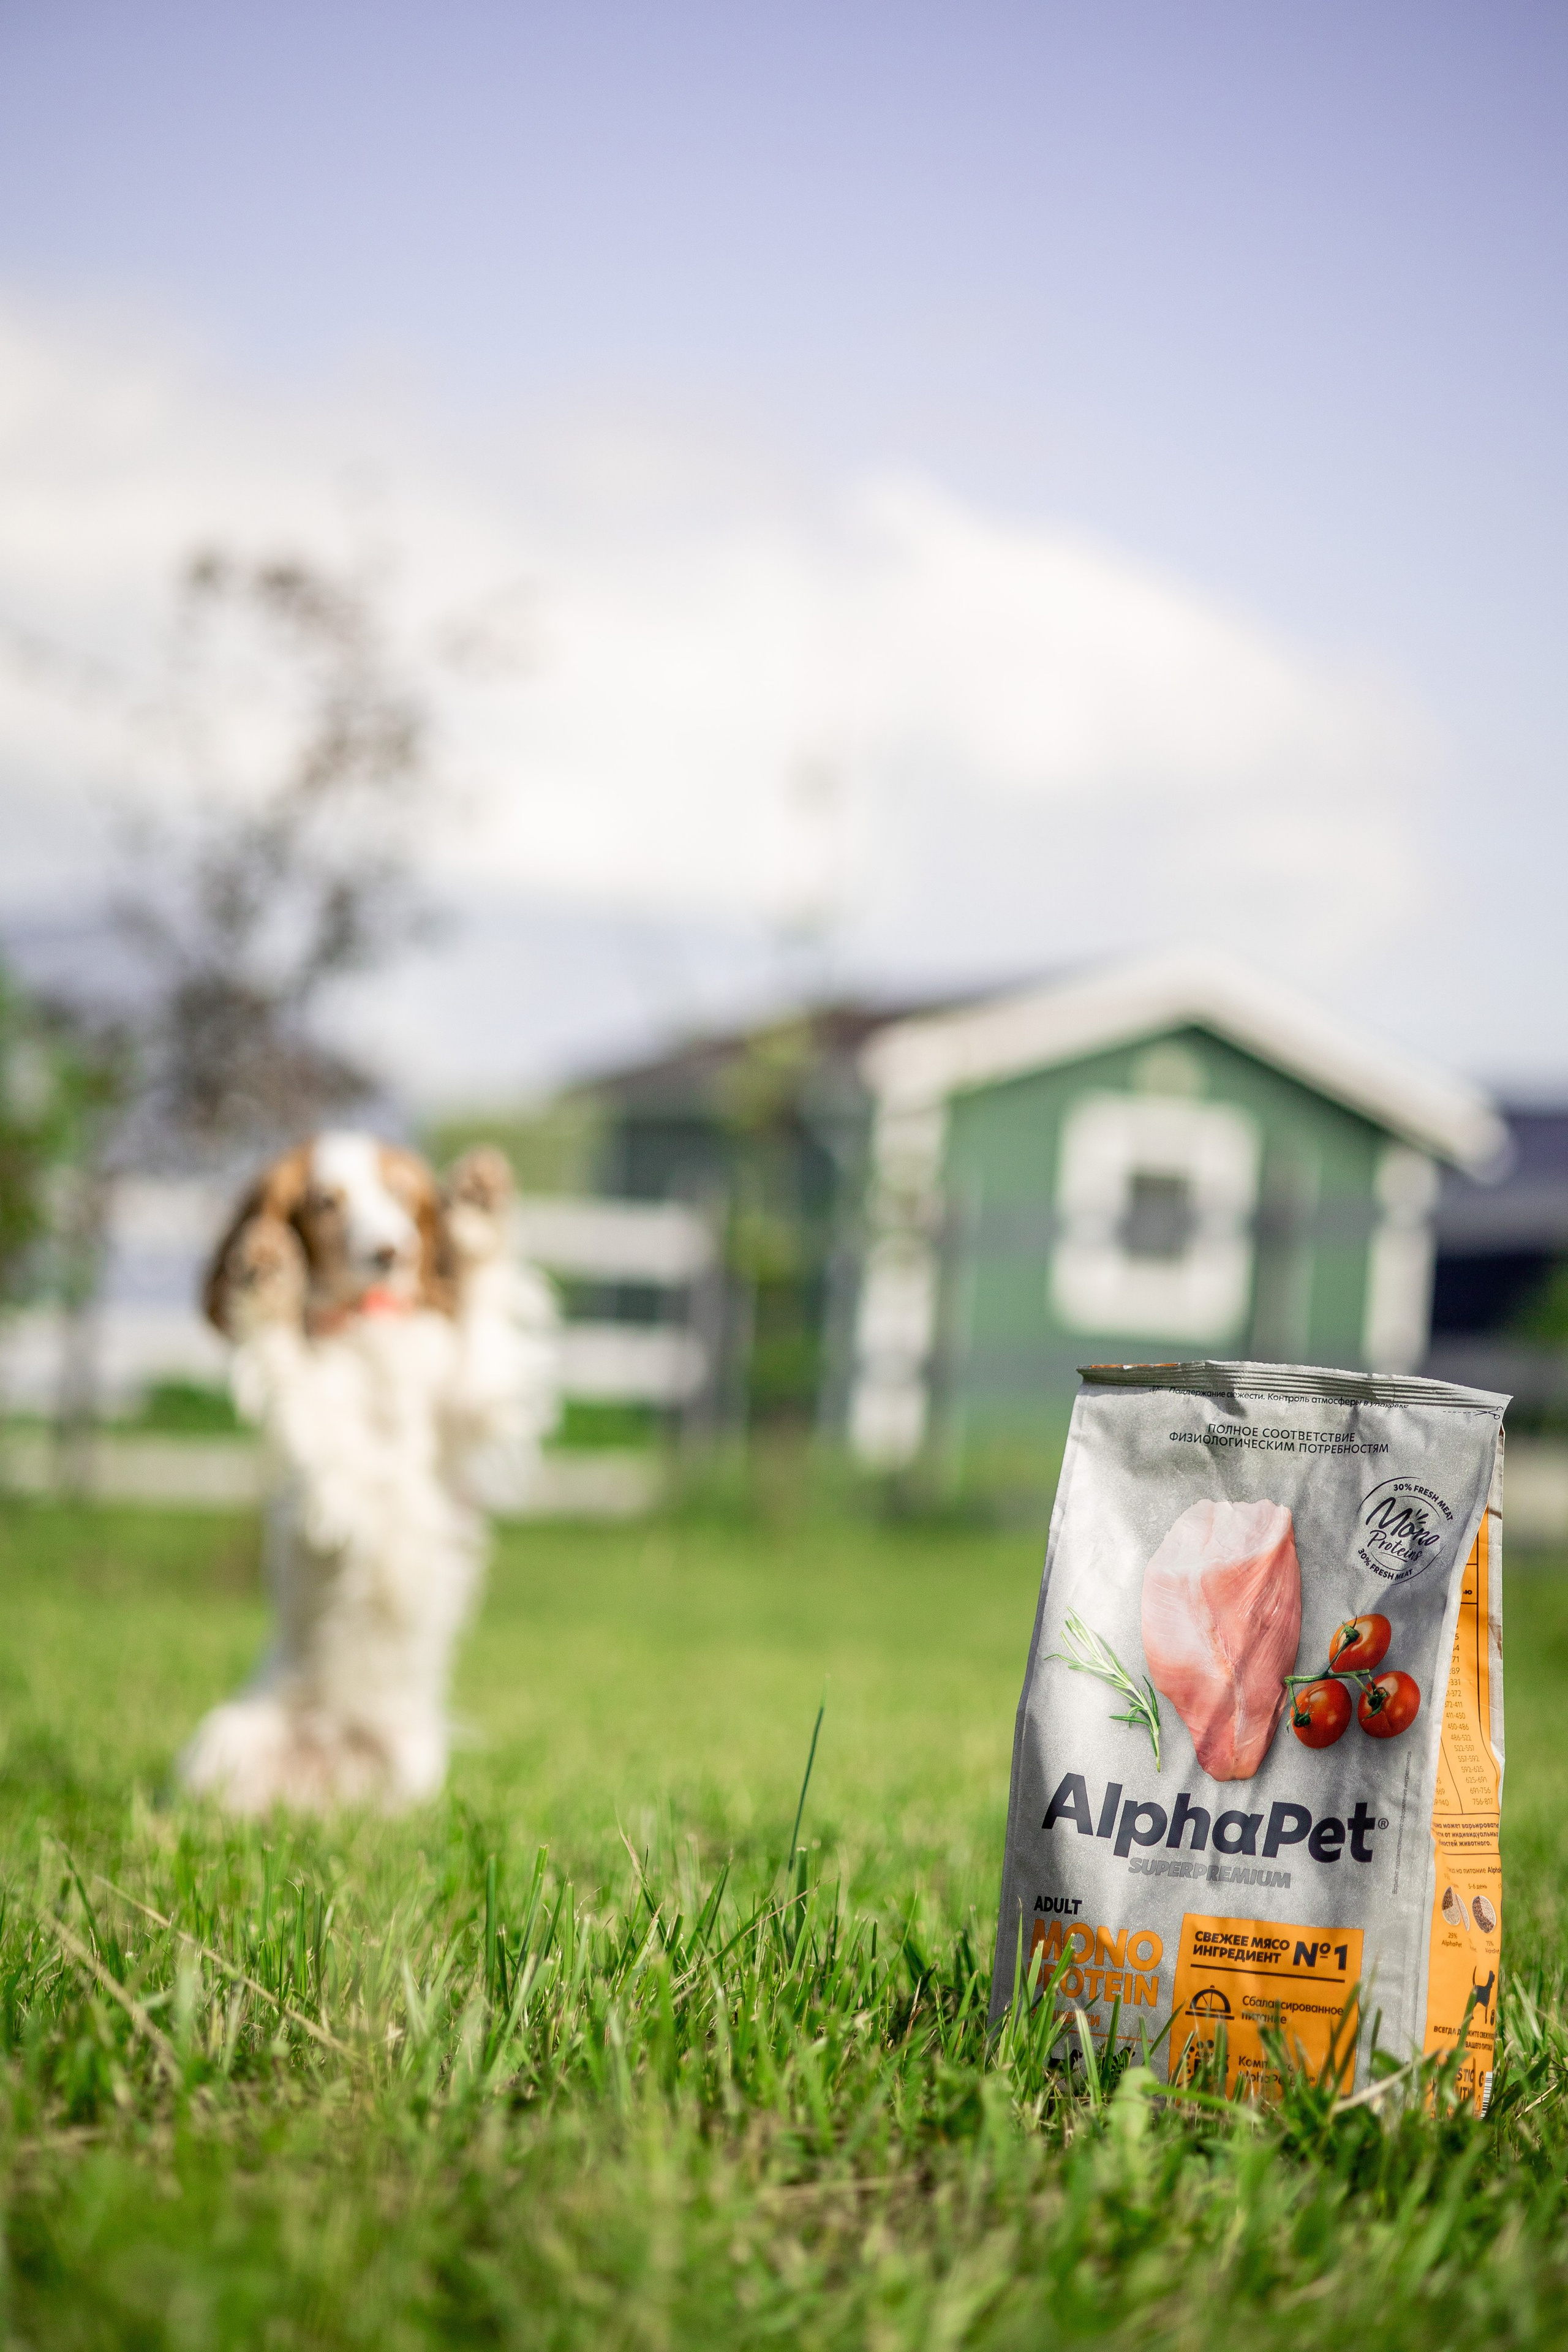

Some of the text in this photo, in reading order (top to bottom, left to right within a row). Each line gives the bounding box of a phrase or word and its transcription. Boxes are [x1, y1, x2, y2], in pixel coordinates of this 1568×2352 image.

[1226, 1392, 1265, 1400] свежести.
[1267, 1393, 1310, 1404] Контроль
[1311, 1396, 1362, 1407] атмосферы
[1169, 1431, 1389, 1454] ФИЗИОЛОГИЧЕСКИМ ПОТРЕБНОСТЯМ
[1207, 1423, 1355, 1442] ПОЛНОЕ СООТВЕТСТВИЕ
[1414, 1485, 1439, 1502] FRESH
[1437, 1500, 1453, 1521] MEAT
[1367, 1529, 1423, 1561] Proteins
[1358, 1548, 1414, 1581] 30% FRESH MEAT
[1128, 1857, 1292, 1889] SUPERPREMIUM
[1034, 1896, 1082, 1915] ADULT
[1029, 1918, 1164, 1972] MONO
[1194, 1931, 1291, 1951] СВЕЖЕЕ МЯСО
[1193, 1944, 1282, 1964] ИНГРЕДИЕНТ
[1242, 1995, 1344, 2016] Сбаласированное
[1241, 2011, 1287, 2025] питане
[1433, 2026, 1457, 2036] ВСЕГДА
